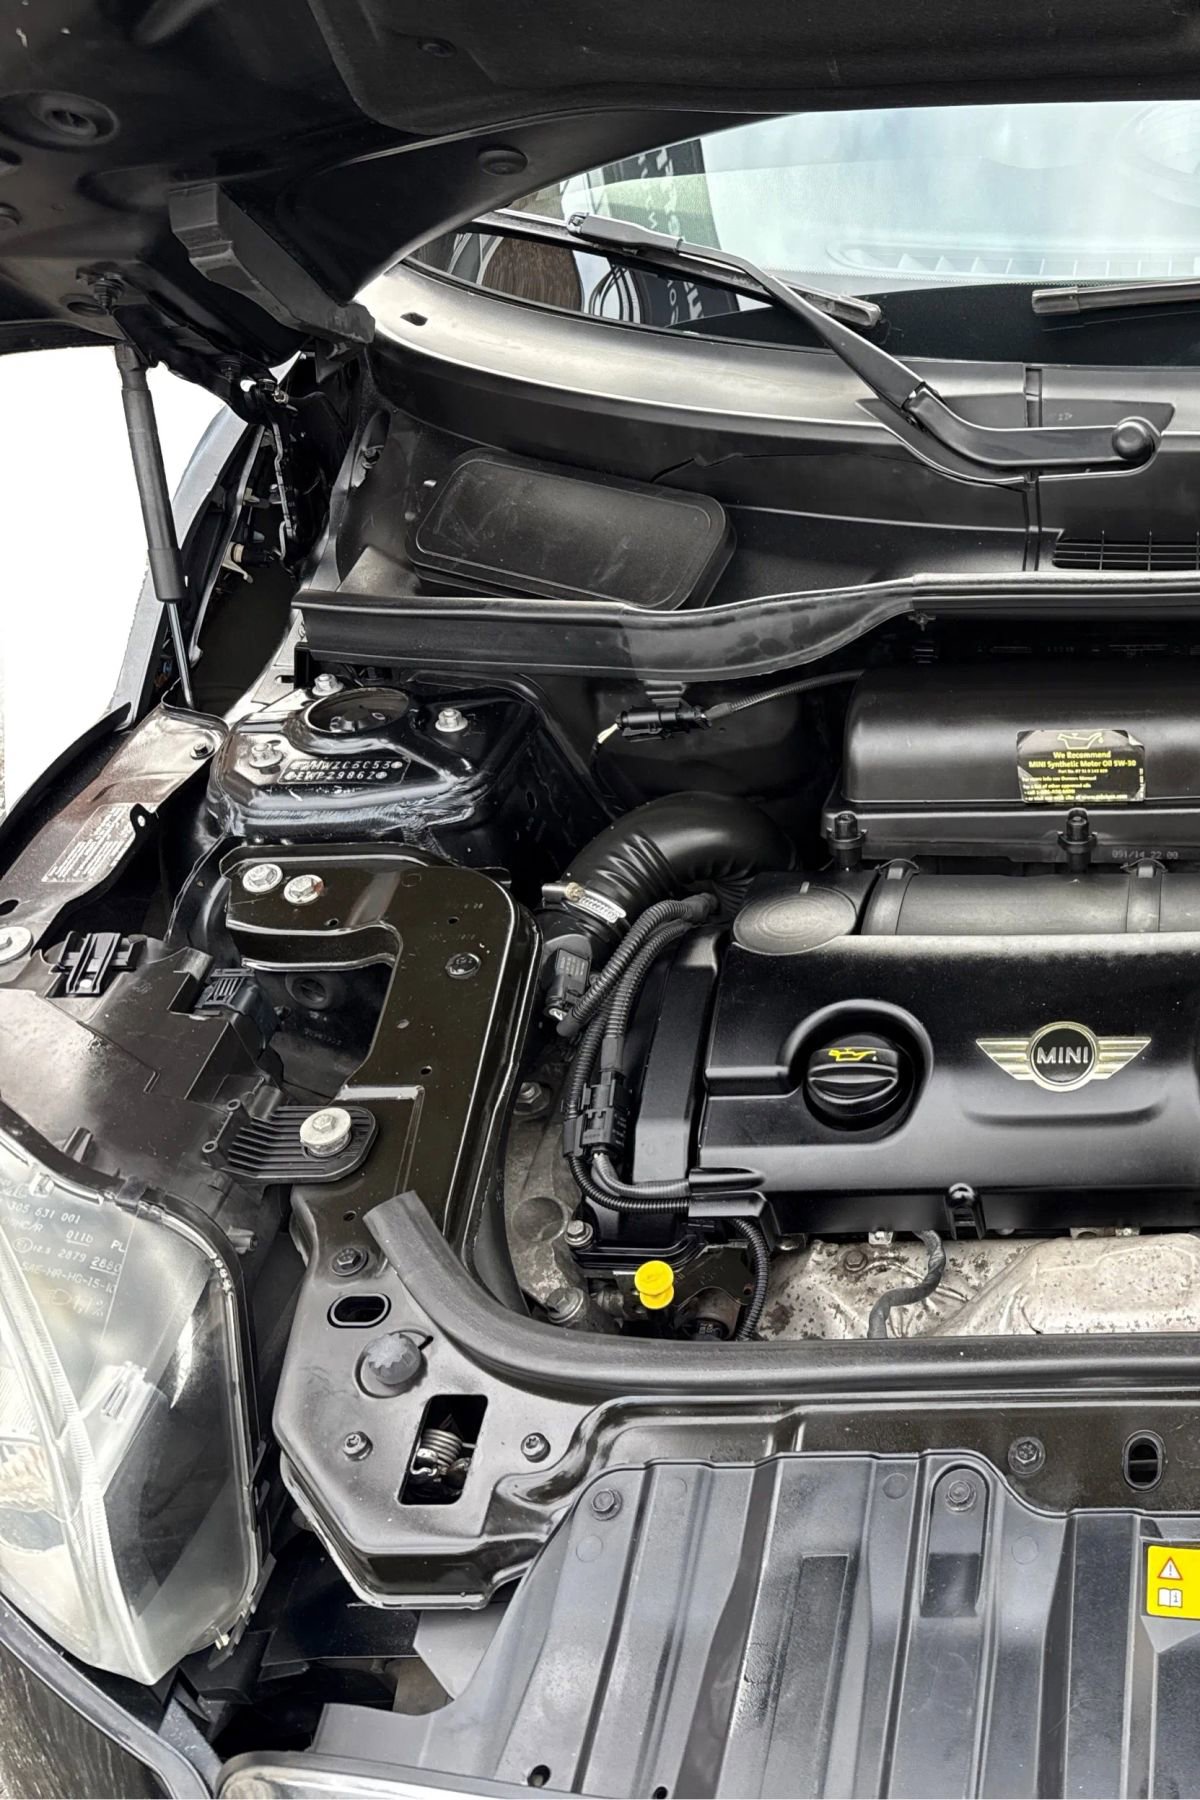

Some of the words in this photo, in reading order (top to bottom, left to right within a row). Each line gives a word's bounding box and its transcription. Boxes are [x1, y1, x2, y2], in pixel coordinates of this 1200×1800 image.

[1066, 750, 1111, 758] Recommend
[1047, 760, 1079, 769] Synthetic
[1036, 1046, 1089, 1064] MINI
[111, 1239, 126, 1253] PL
[58, 1248, 87, 1263] 2879
